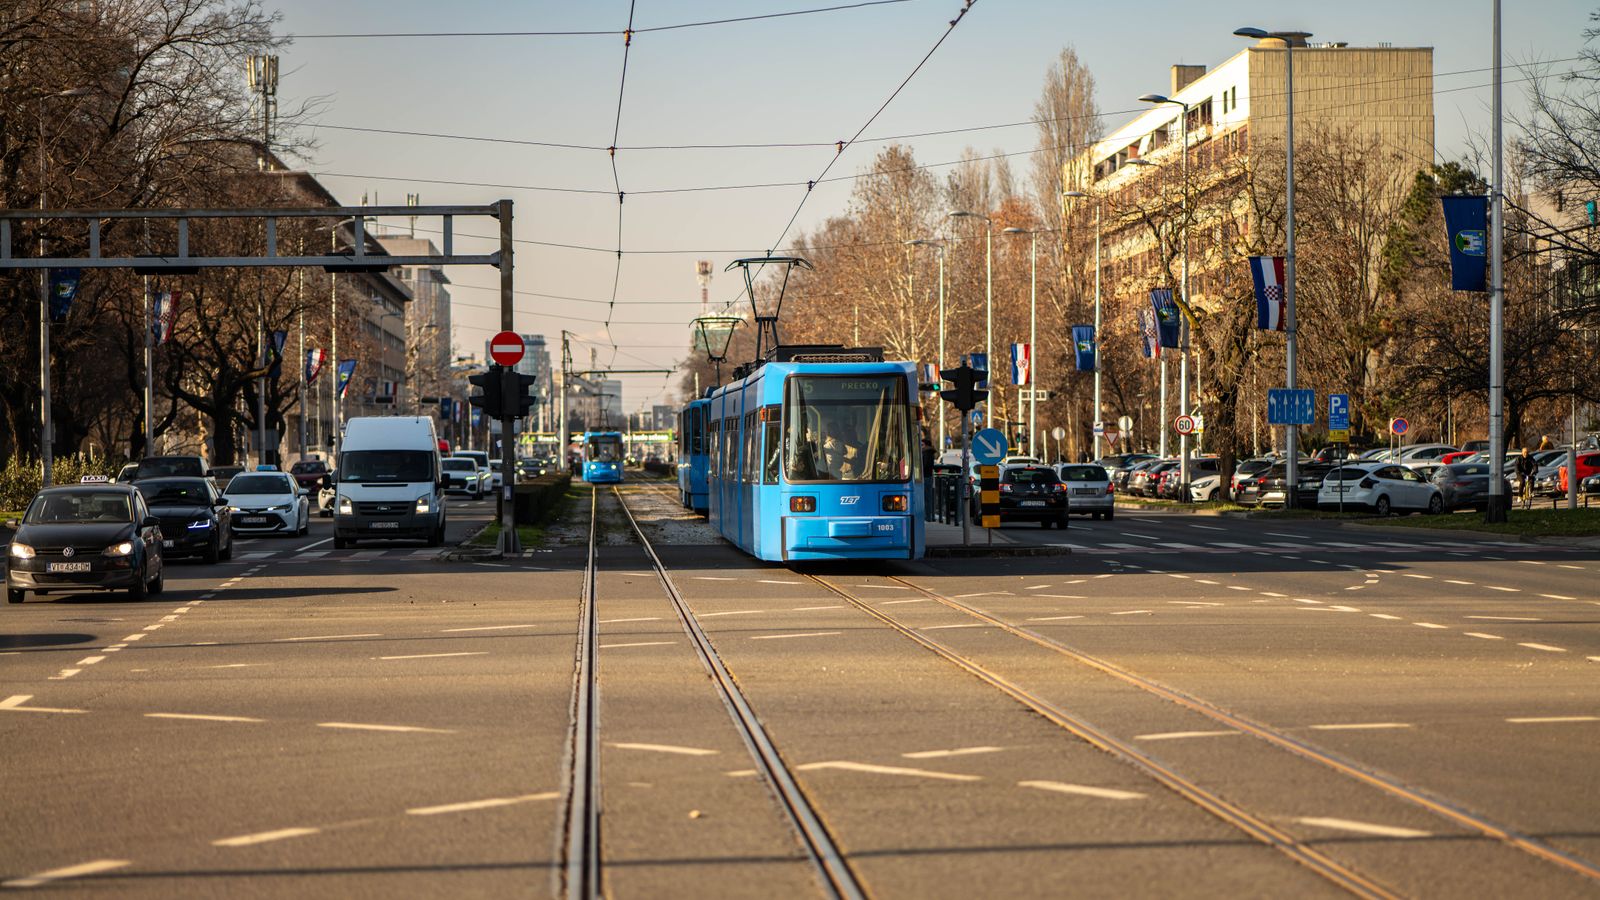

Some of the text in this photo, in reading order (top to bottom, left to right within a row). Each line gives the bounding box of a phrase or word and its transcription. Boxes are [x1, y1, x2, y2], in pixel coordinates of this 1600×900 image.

[803, 381, 814, 394] 5
[1331, 396, 1342, 414] P
[1179, 419, 1191, 430] 60
[840, 496, 860, 505] ZET
